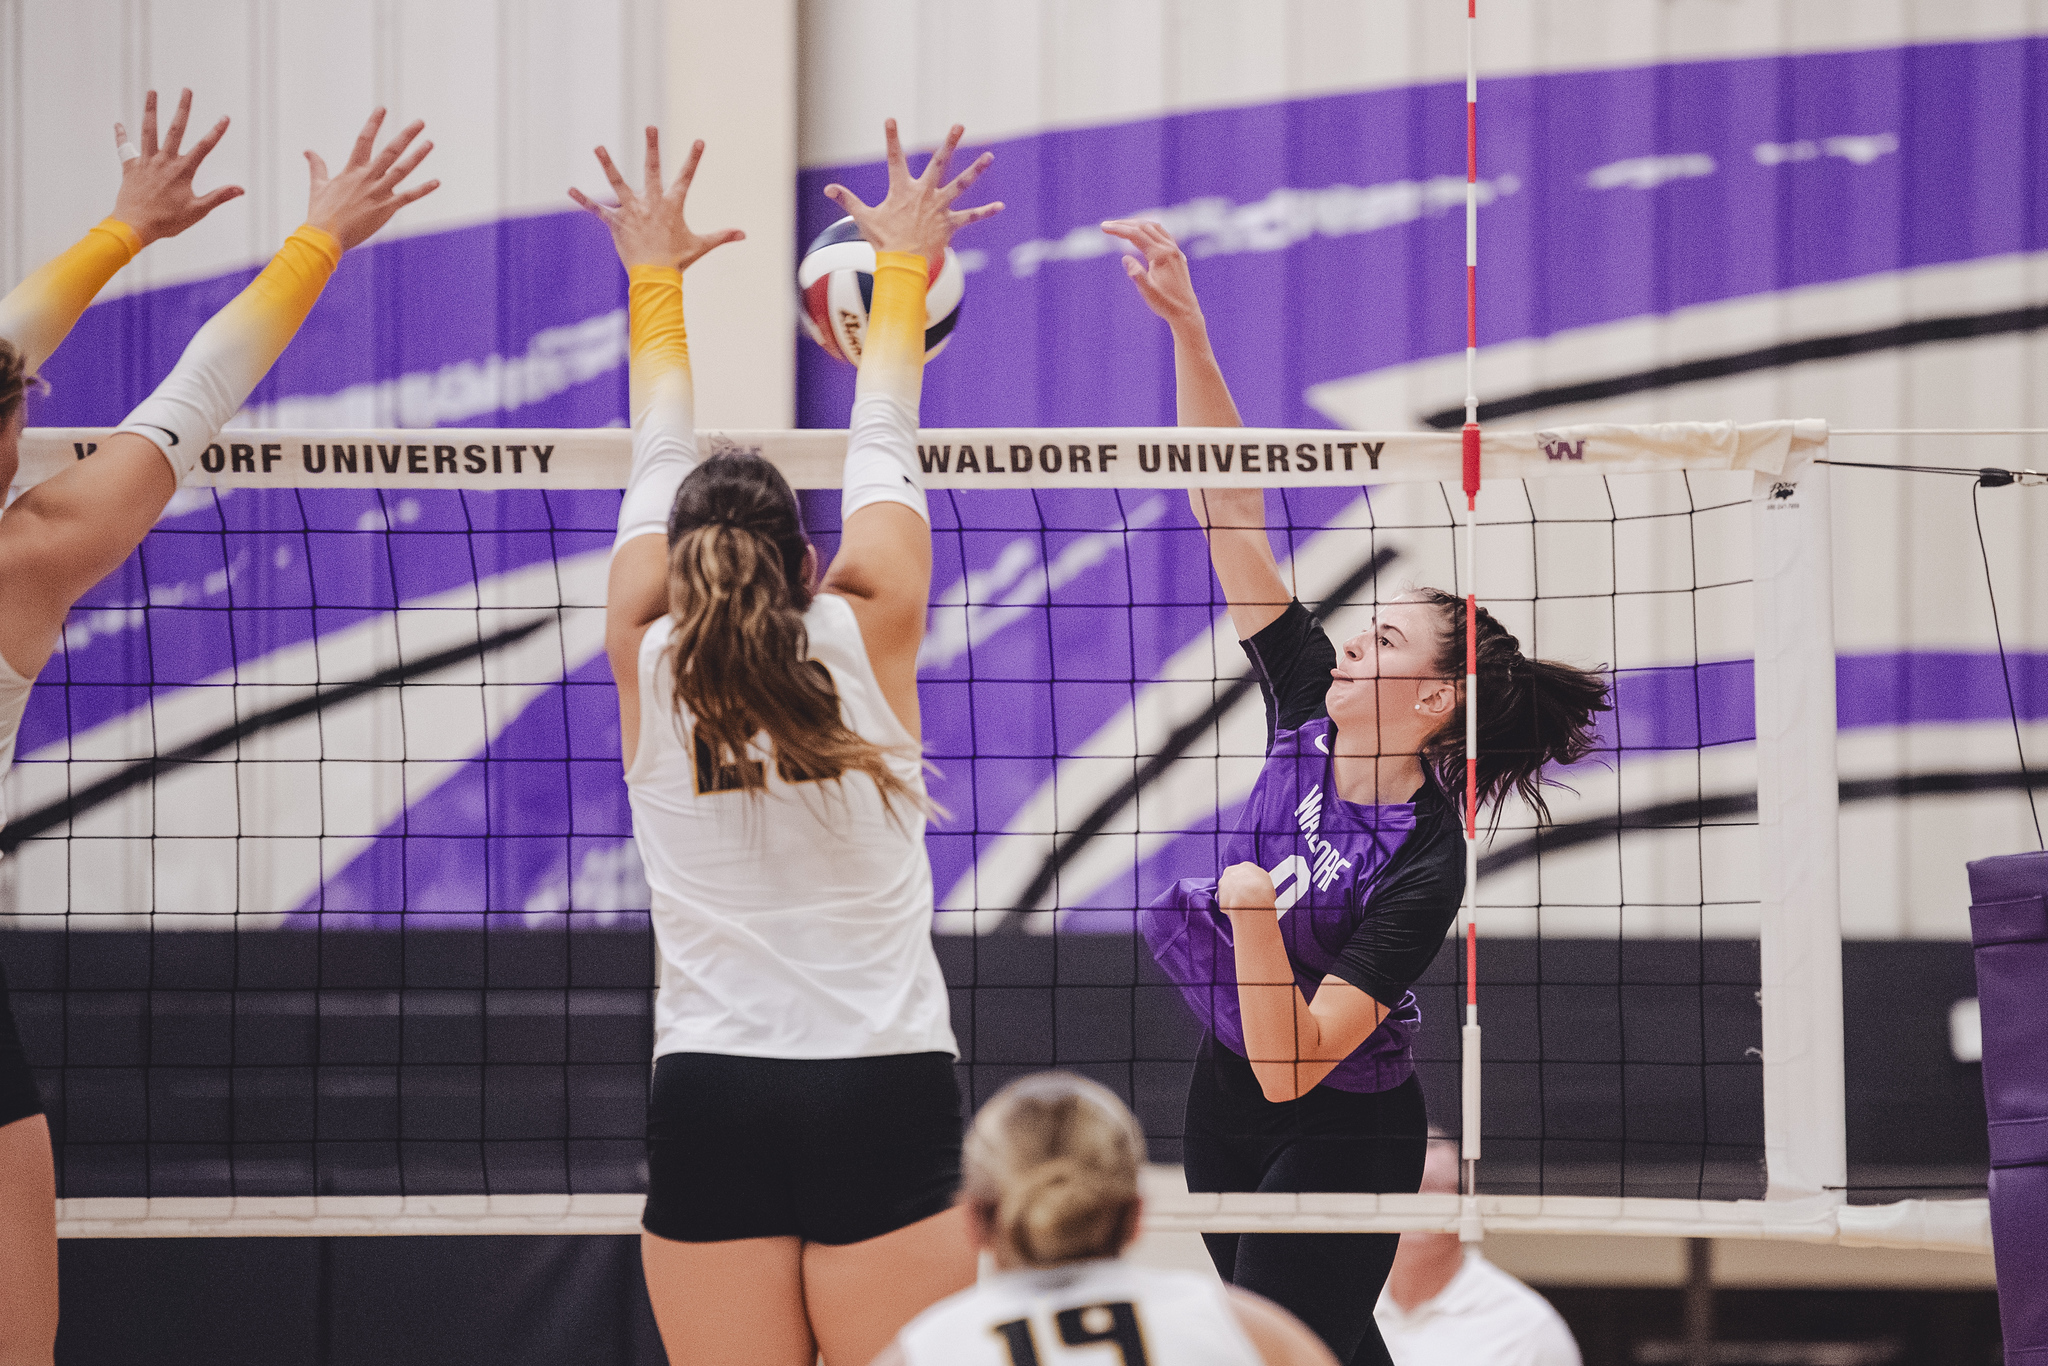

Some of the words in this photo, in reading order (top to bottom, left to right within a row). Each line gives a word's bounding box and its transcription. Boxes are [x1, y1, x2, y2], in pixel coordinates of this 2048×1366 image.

[303, 444, 556, 475] UNIVERSITY
[918, 444, 1118, 474] WALDORF
[1138, 441, 1386, 473] UNIVERSITY
[1294, 784, 1352, 892] WALORF
